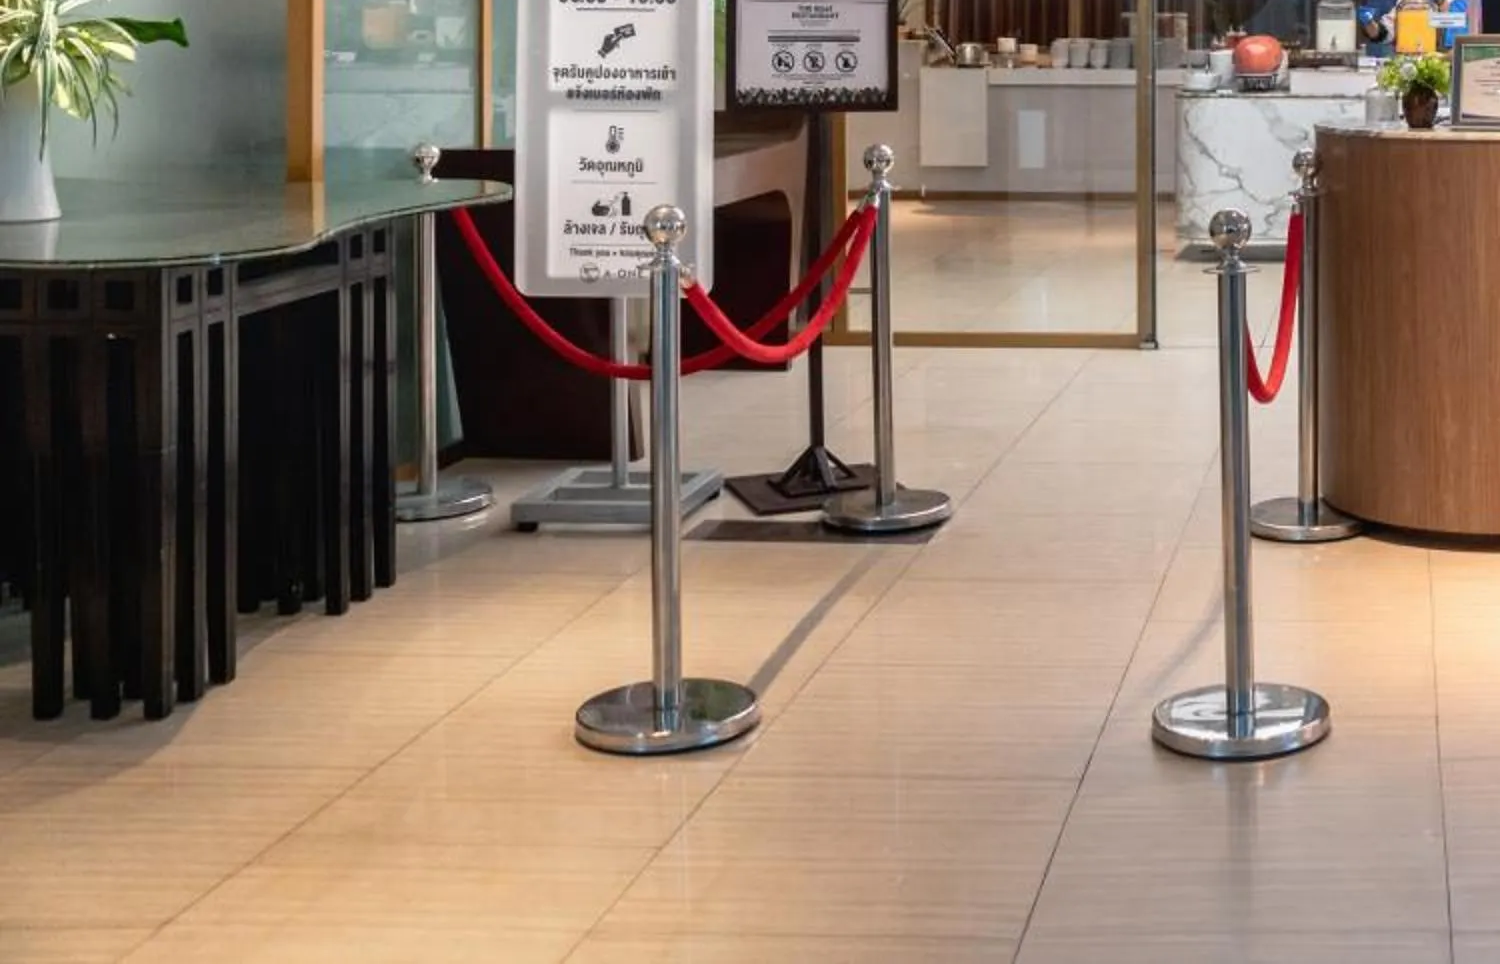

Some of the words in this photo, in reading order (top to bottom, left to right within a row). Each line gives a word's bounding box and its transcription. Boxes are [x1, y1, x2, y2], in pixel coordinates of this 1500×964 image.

[578, 157, 644, 177] วัดอุณหภูมิ
